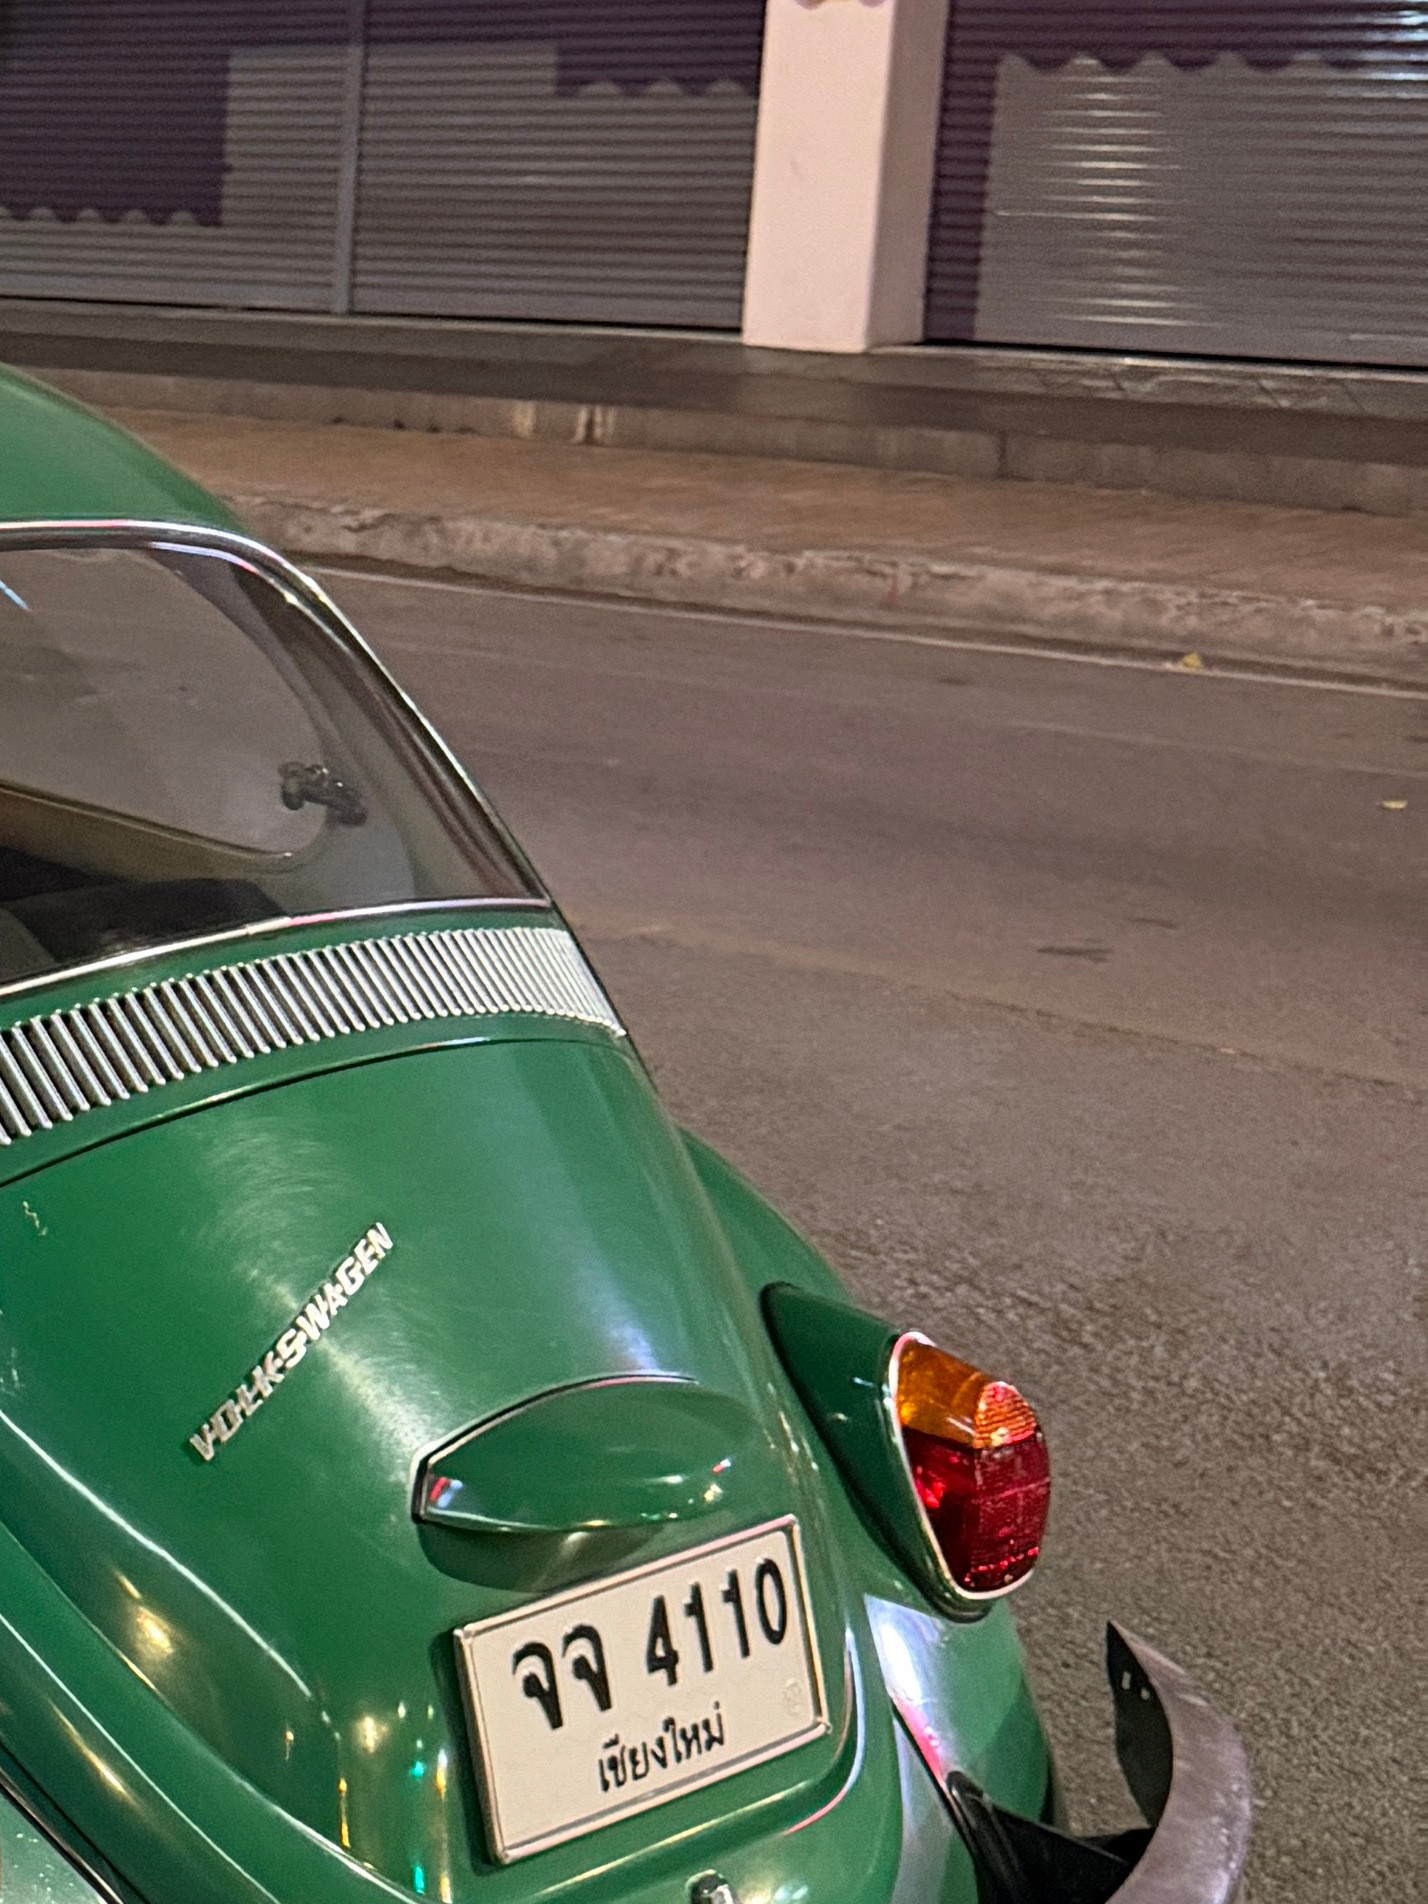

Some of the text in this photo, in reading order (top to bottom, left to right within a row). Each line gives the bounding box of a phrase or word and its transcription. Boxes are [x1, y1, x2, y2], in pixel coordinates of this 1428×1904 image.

[189, 1221, 394, 1461] VOLKSWAGEN
[511, 1557, 787, 1730] จจ 4110
[597, 1700, 726, 1792] เชียงใหม่
